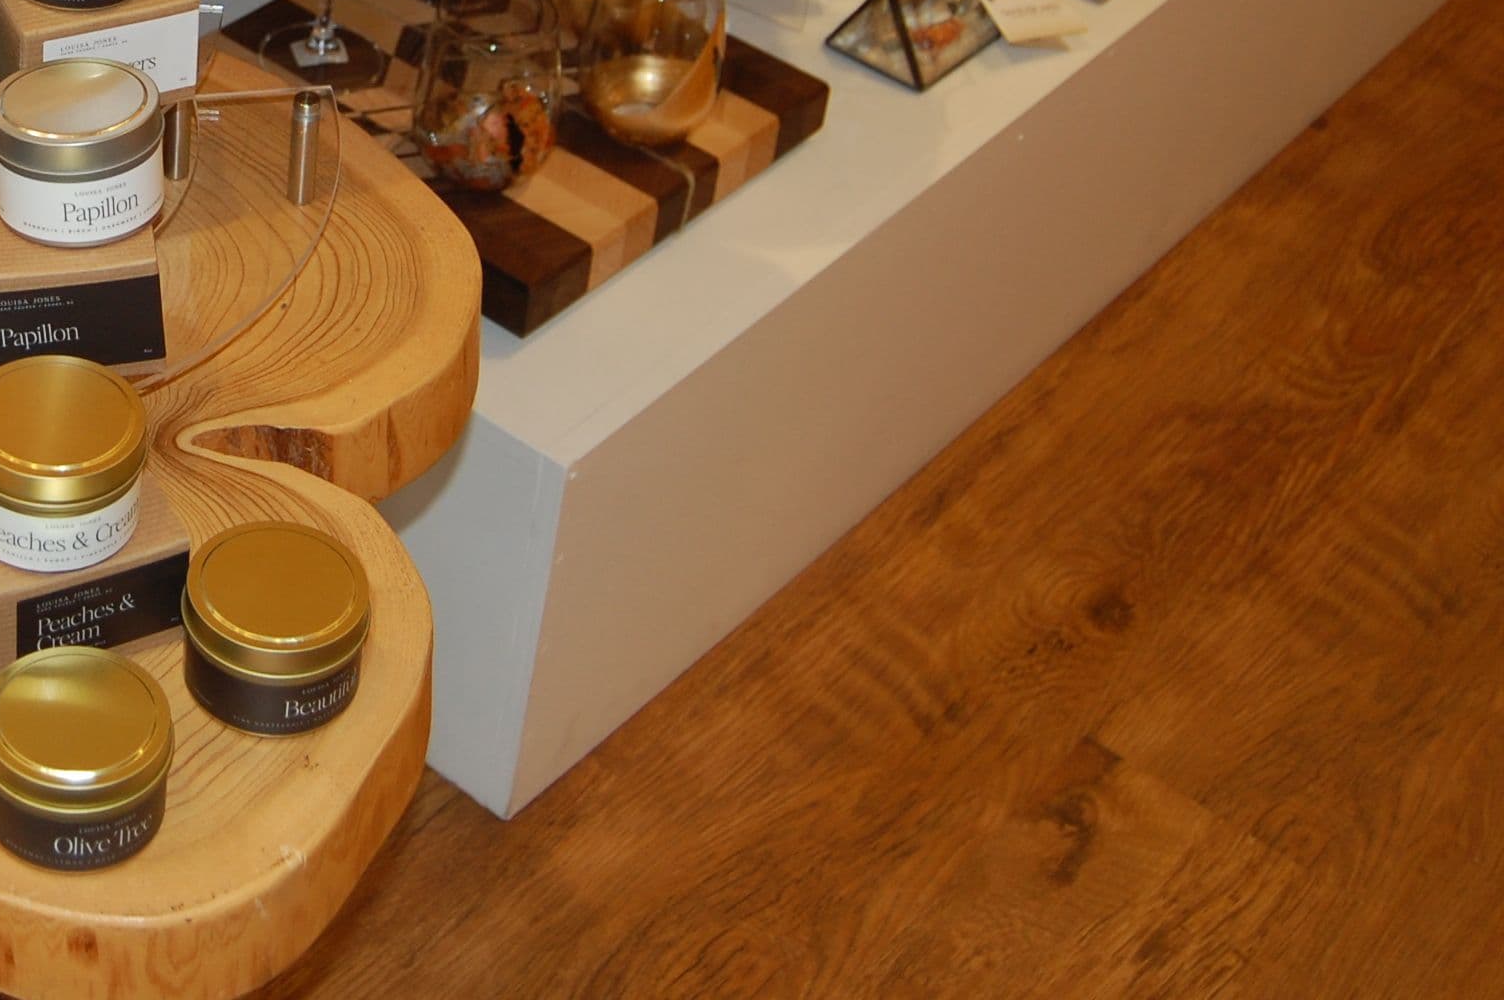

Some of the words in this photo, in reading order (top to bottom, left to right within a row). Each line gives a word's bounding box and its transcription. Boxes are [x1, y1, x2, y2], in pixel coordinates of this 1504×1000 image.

[60, 42, 90, 52] LOUISA
[93, 36, 118, 45] JONES
[74, 188, 103, 198] LOUISA
[106, 181, 128, 193] JONES
[63, 193, 139, 226] Papillon
[33, 295, 61, 304] JONES
[0, 323, 81, 350] Papillon
[72, 531, 89, 551] &
[36, 594, 70, 610] LOUISA
[72, 587, 101, 599] JONES
[38, 602, 115, 637] Peaches
[119, 593, 137, 612] &
[37, 625, 101, 651] Cream
[53, 834, 112, 857] Olive
[113, 813, 153, 848] Tree
